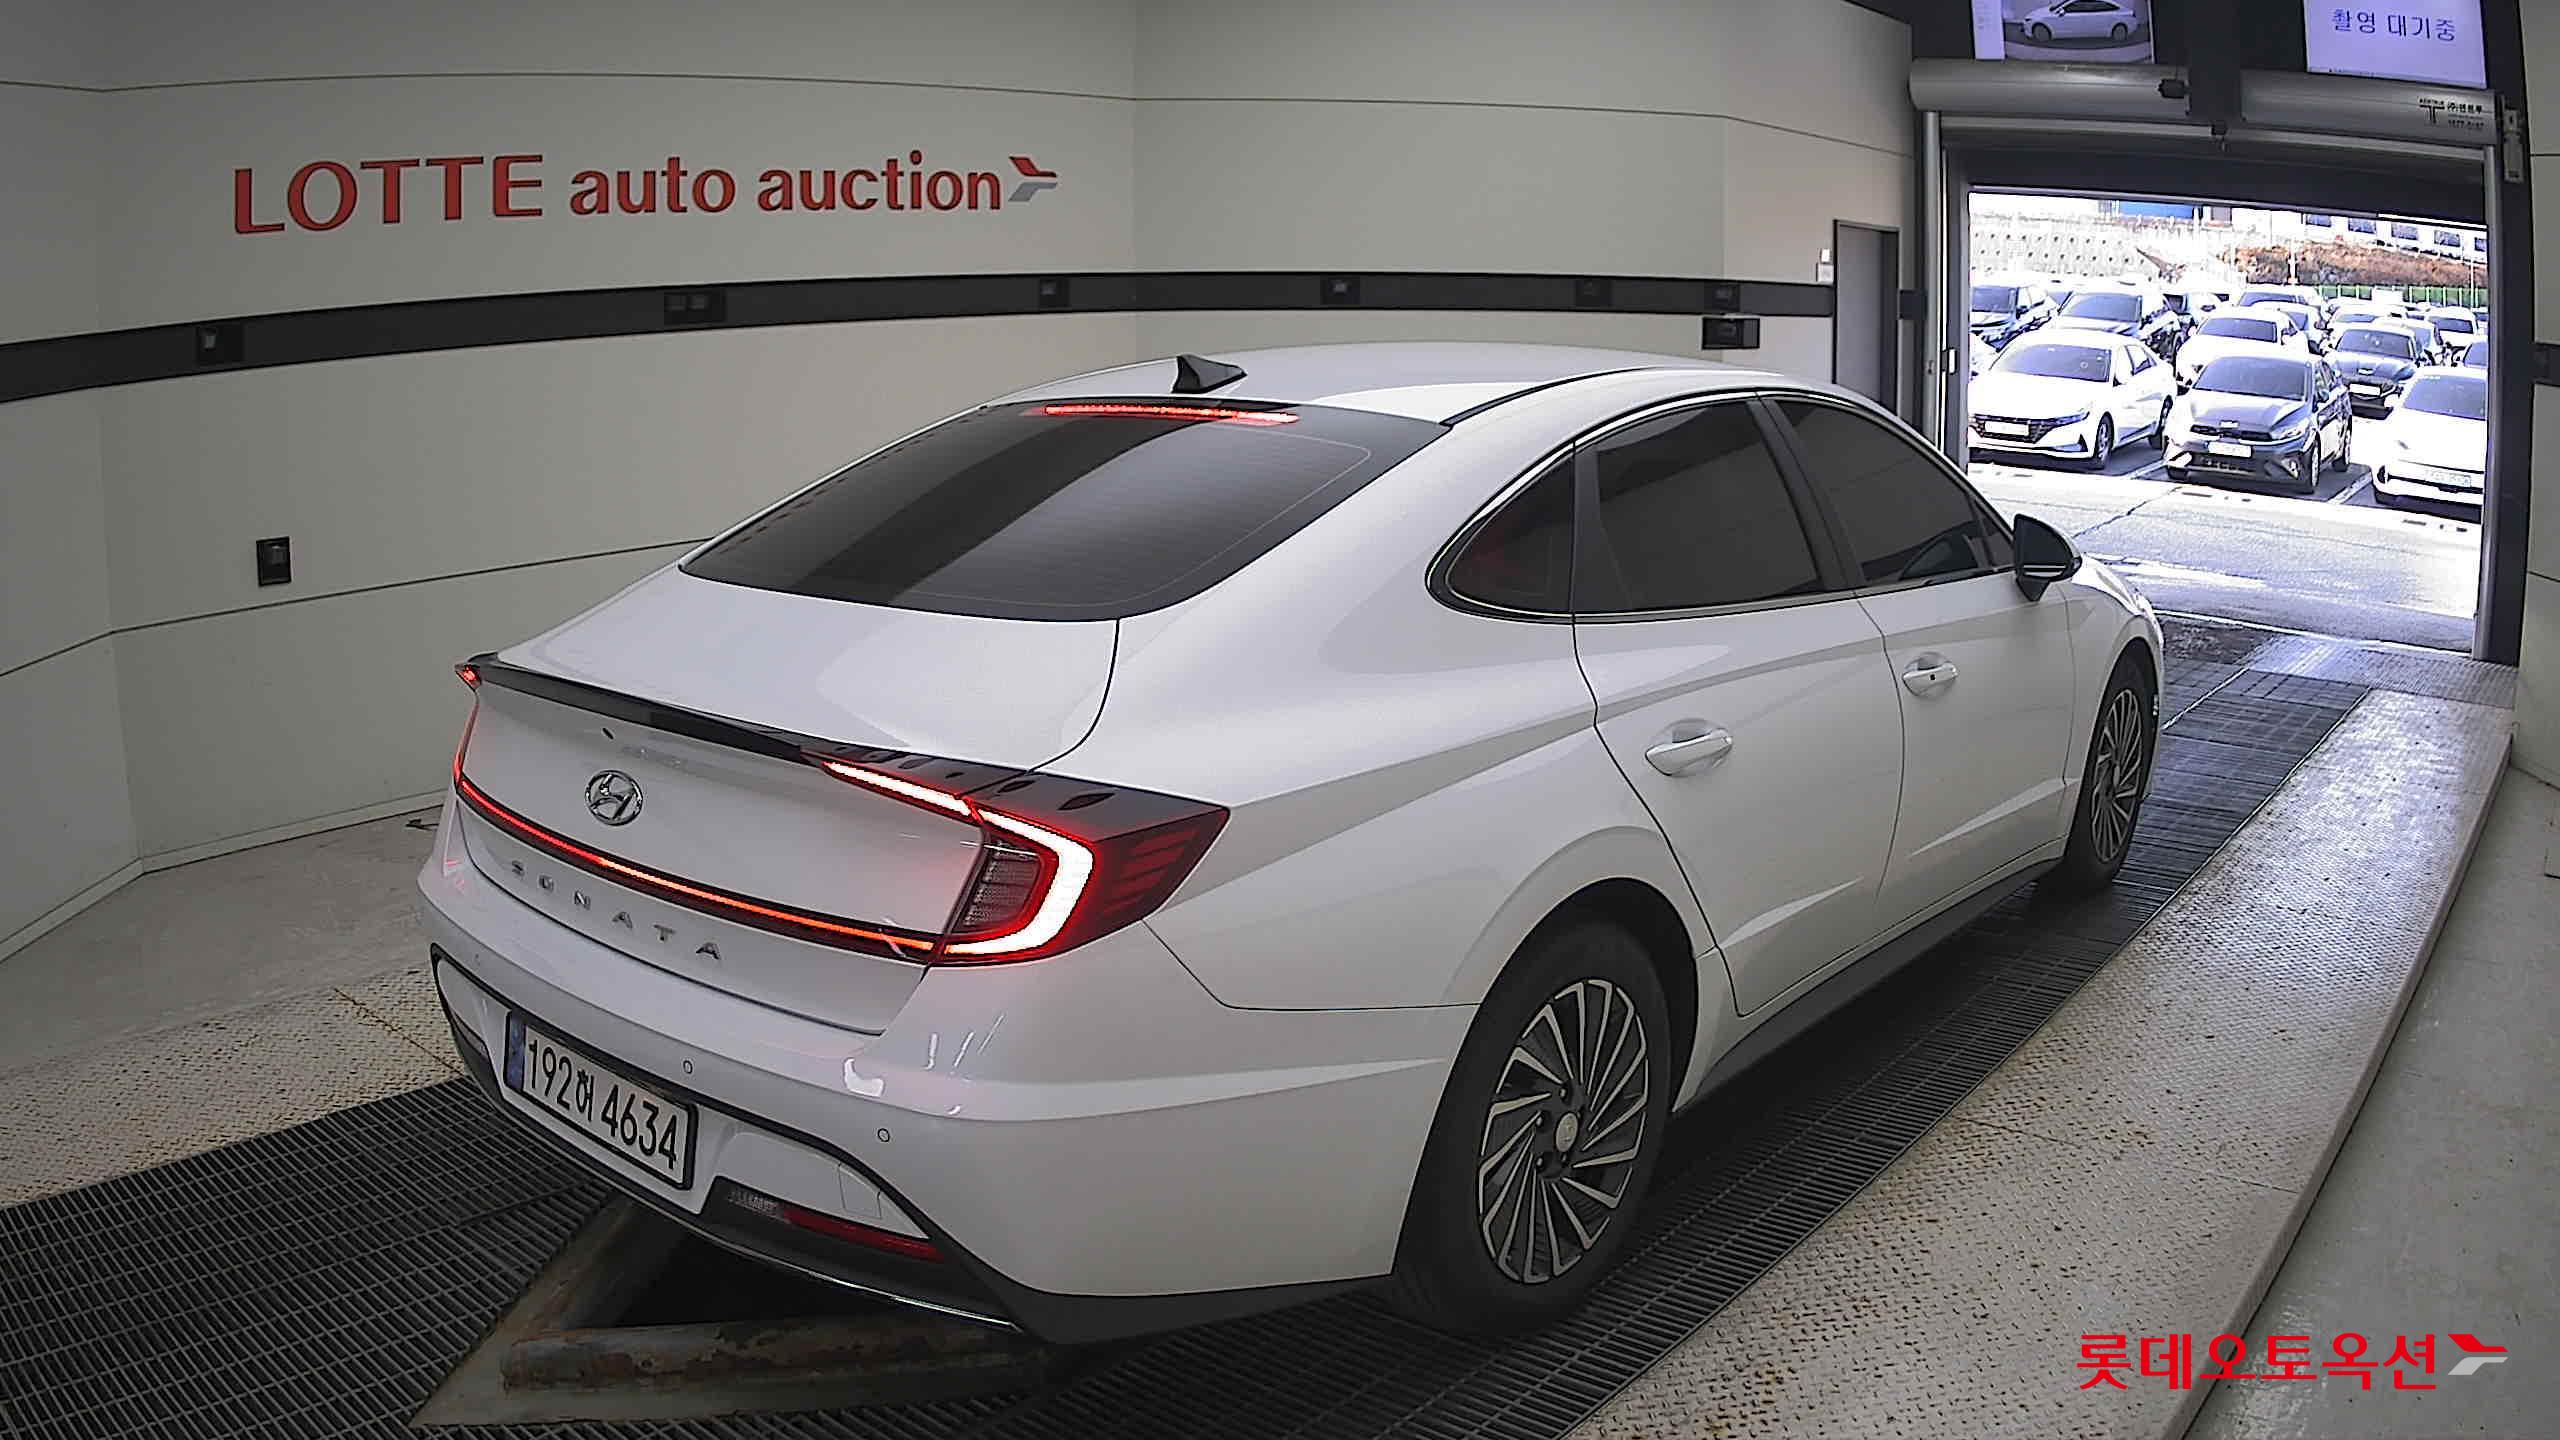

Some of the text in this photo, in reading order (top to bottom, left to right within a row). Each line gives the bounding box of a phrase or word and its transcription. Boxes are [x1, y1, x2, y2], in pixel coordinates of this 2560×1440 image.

[2332, 8, 2456, 42] 촬영 대기중
[233, 149, 1002, 235] LOTTE auto auction
[511, 859, 722, 961] SONATA
[600, 1083, 678, 1171] 4634
